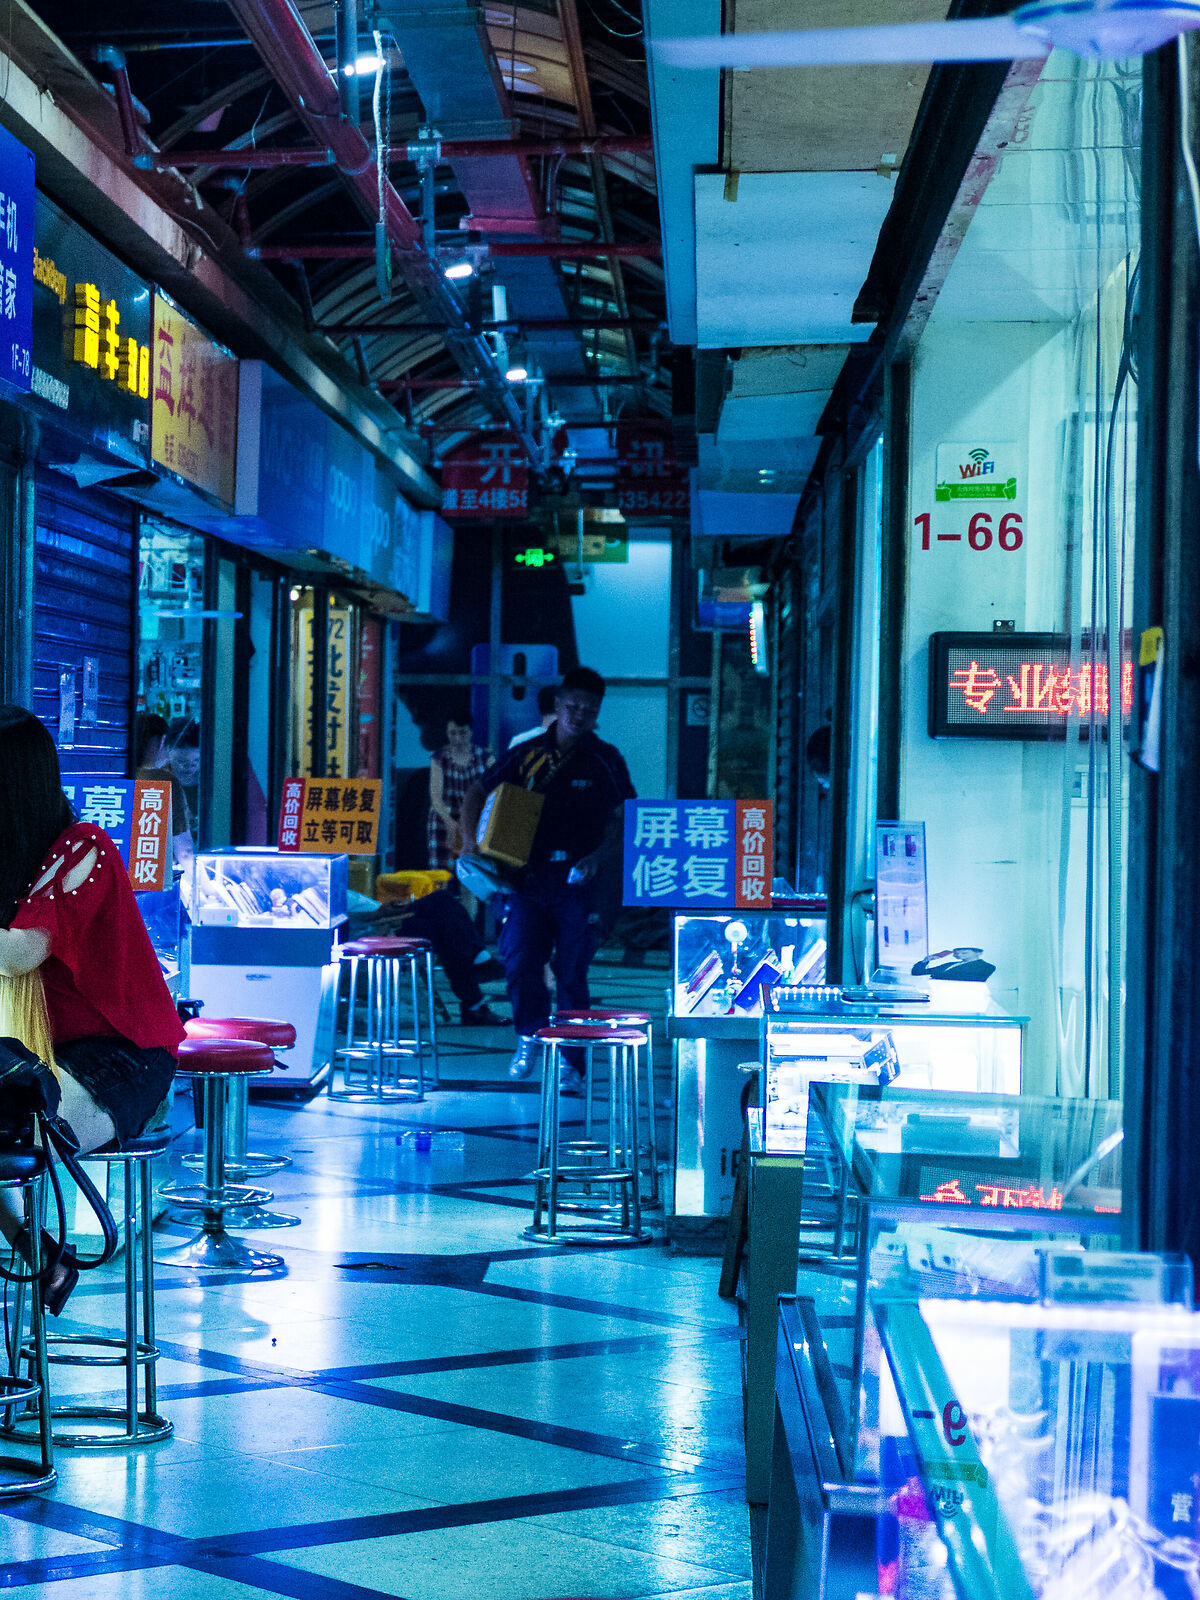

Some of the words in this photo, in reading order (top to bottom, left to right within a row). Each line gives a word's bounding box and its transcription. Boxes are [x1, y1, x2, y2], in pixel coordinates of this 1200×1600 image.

[913, 512, 1024, 551] 1-66
[282, 782, 303, 846] 高价回收
[305, 786, 376, 813] 屏幕修复
[134, 787, 165, 884] 高价回收
[303, 818, 373, 845] 立等可取
[633, 806, 730, 850] 屏幕
[632, 854, 729, 898] 修复
[741, 806, 767, 902] 高价回收
